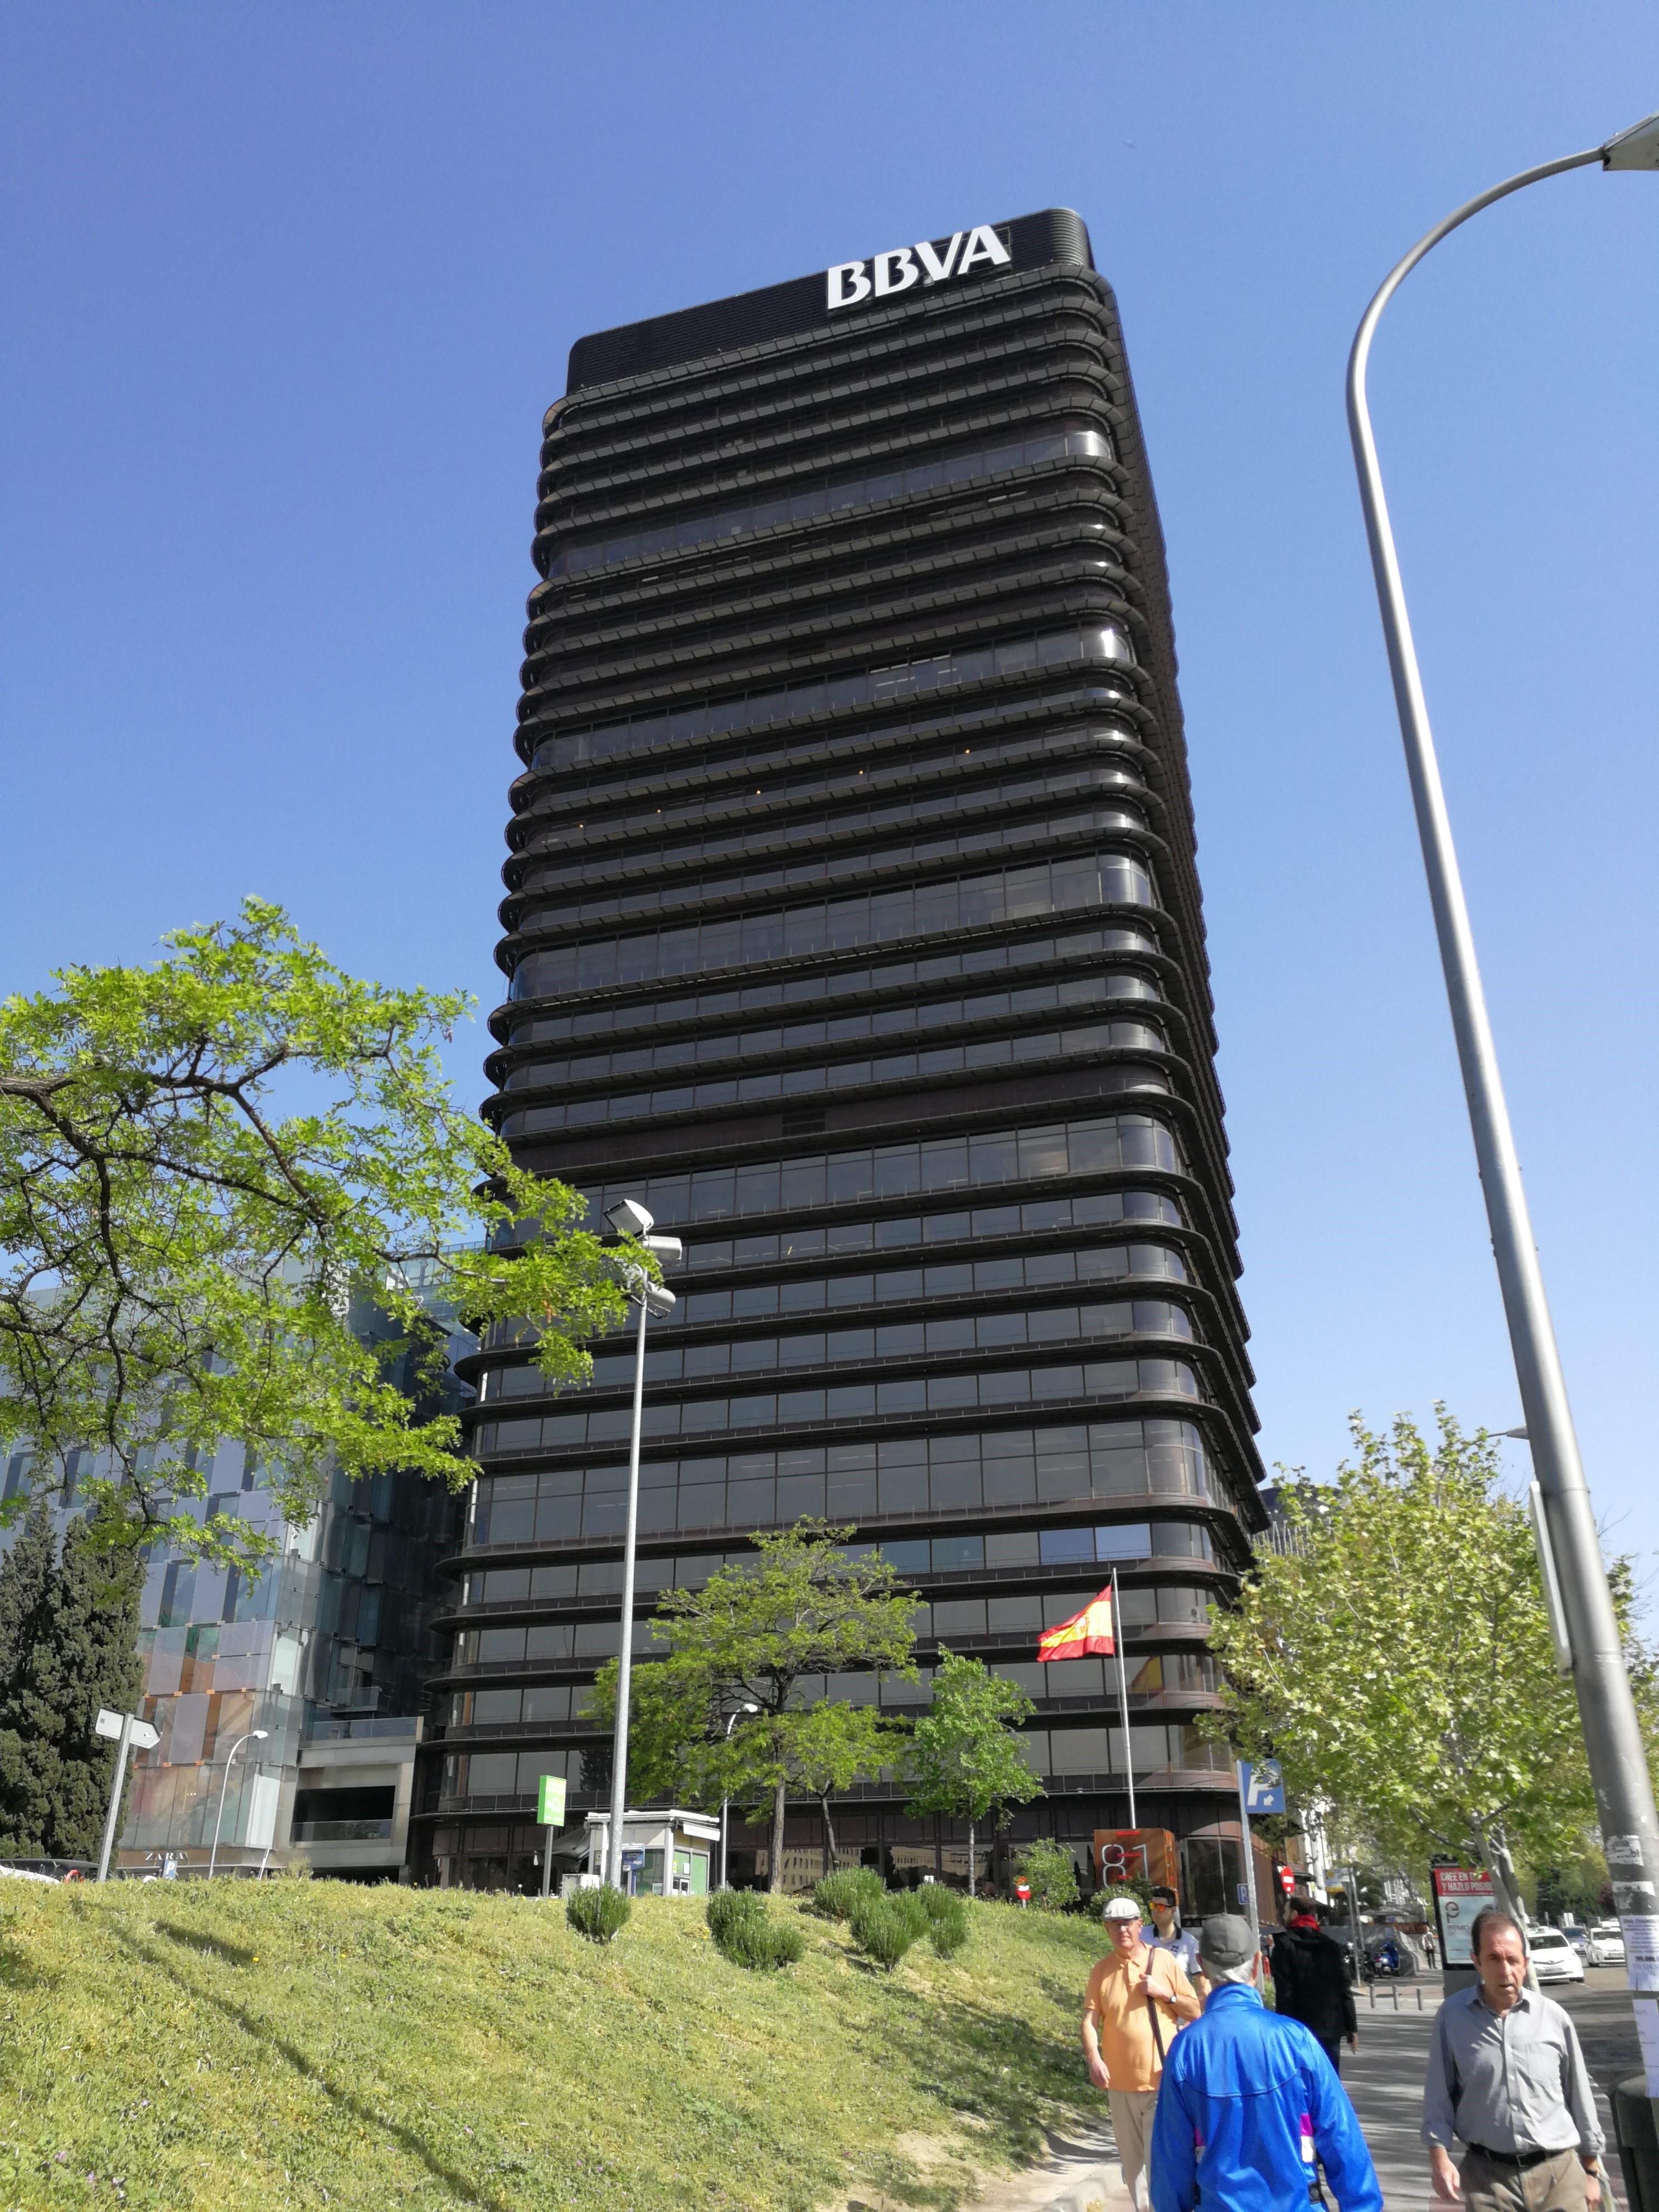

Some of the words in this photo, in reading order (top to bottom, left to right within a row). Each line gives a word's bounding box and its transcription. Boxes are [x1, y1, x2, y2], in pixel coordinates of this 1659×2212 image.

[828, 225, 1011, 309] BBVA
[145, 1852, 183, 1860] ZARA
[165, 1861, 175, 1875] P
[1102, 1844, 1149, 1888] 81
[1440, 1872, 1458, 1881] CREE
[1458, 1872, 1468, 1881] EN
[1240, 1886, 1248, 1901] P
[1441, 1882, 1447, 1891] Y
[1448, 1882, 1470, 1891] HAZLO
[1470, 1882, 1494, 1891] POSIBL
